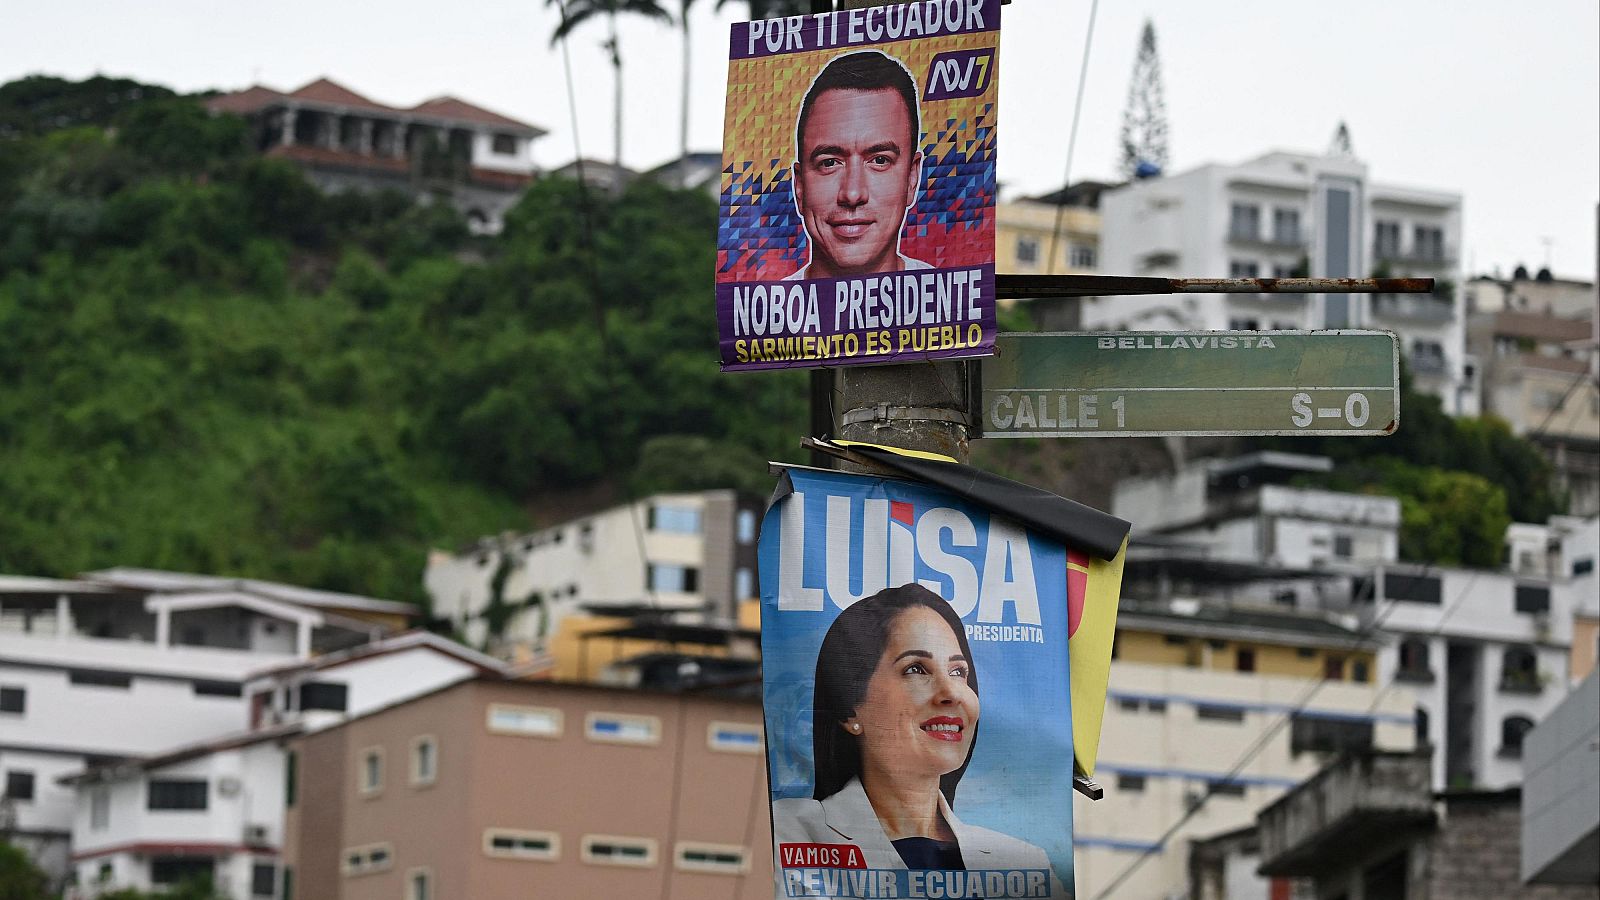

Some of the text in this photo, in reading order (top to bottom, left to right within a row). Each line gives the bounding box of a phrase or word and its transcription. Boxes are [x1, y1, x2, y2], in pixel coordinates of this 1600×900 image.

[748, 0, 985, 54] POR TI ECUADOR
[733, 269, 982, 336] NOBOA PRESIDENTE
[735, 323, 983, 363] SARMIENTO ES PUEBLO
[1097, 336, 1276, 349] BELLAVISTA
[991, 394, 1098, 428] CALLE
[1111, 396, 1125, 427] 1
[965, 624, 1044, 644] PRESIDENTA
[783, 847, 858, 866] VAMOS A
[784, 868, 1046, 898] REVIVIR ECUADOR
